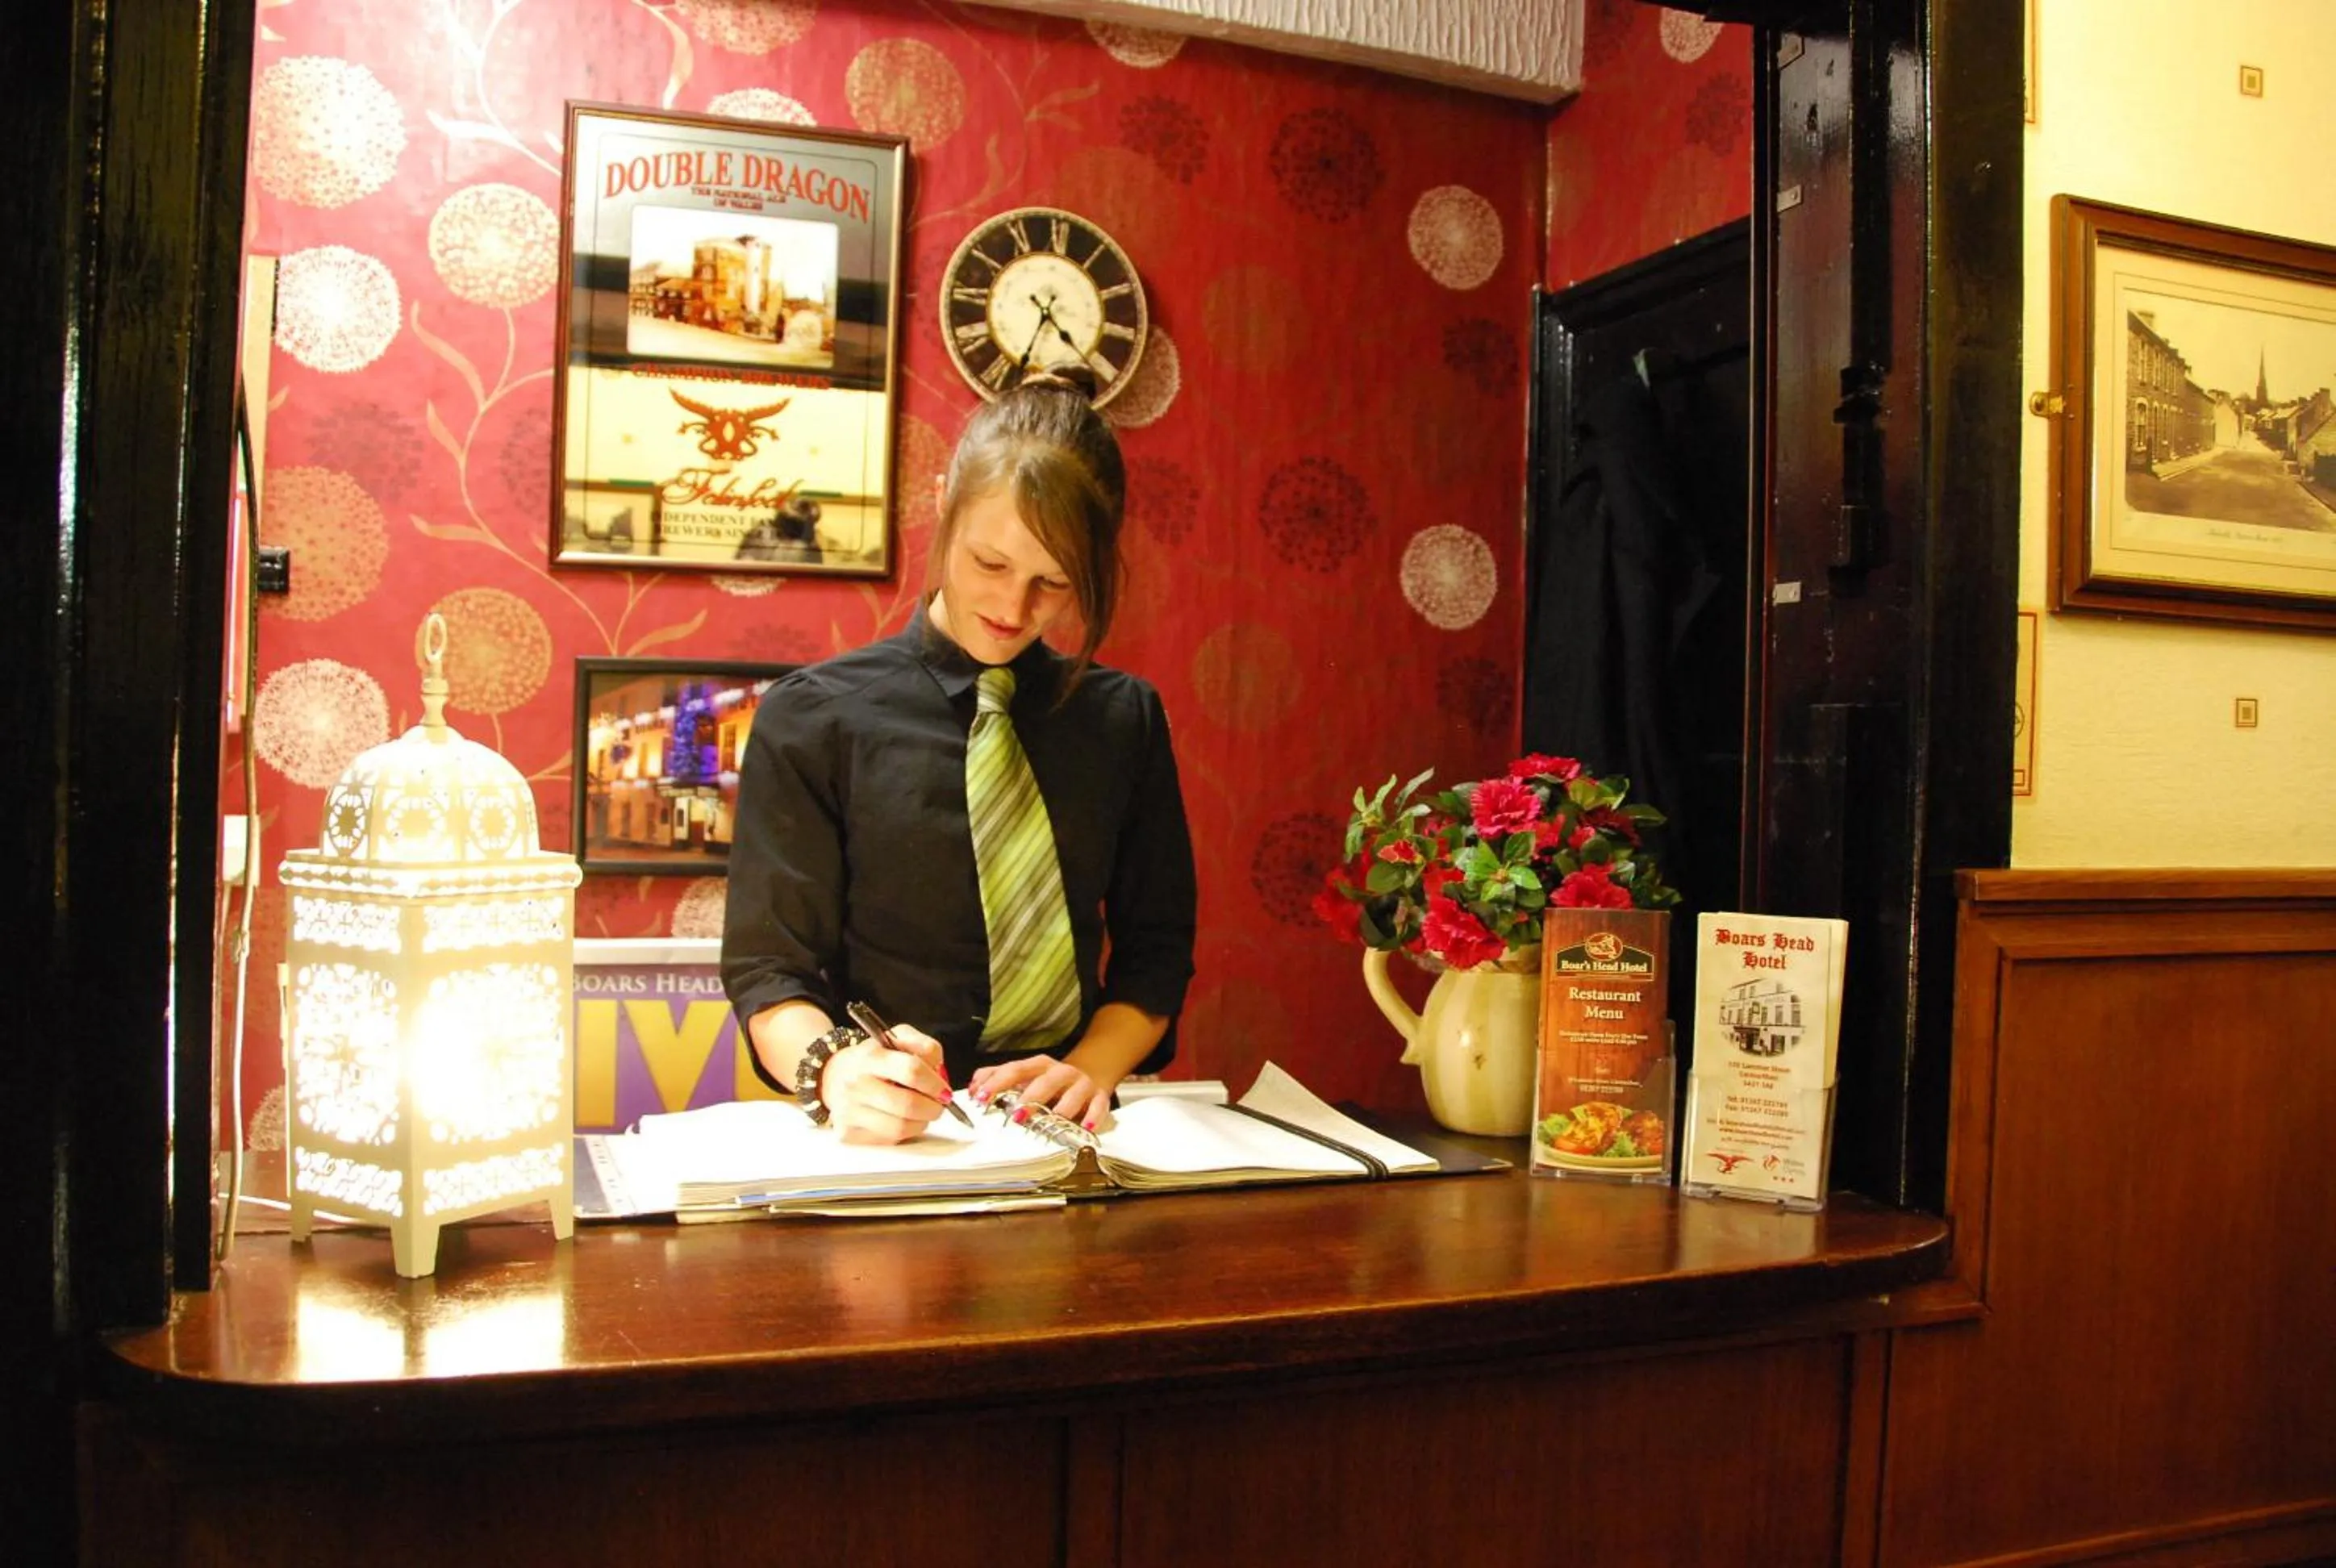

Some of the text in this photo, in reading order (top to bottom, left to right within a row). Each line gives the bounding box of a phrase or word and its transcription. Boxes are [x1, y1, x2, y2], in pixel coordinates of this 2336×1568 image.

[606, 152, 870, 223] DOUBLE DRAGON
[664, 512, 745, 524] DEPENDENT
[1715, 928, 1815, 952] Boars Head
[1561, 959, 1648, 973] Boar's Head Hotel
[1743, 951, 1787, 970] Hotel
[655, 972, 724, 994] HEAD
[1568, 986, 1641, 1003] Restaurant
[1584, 1005, 1625, 1020] Menu
